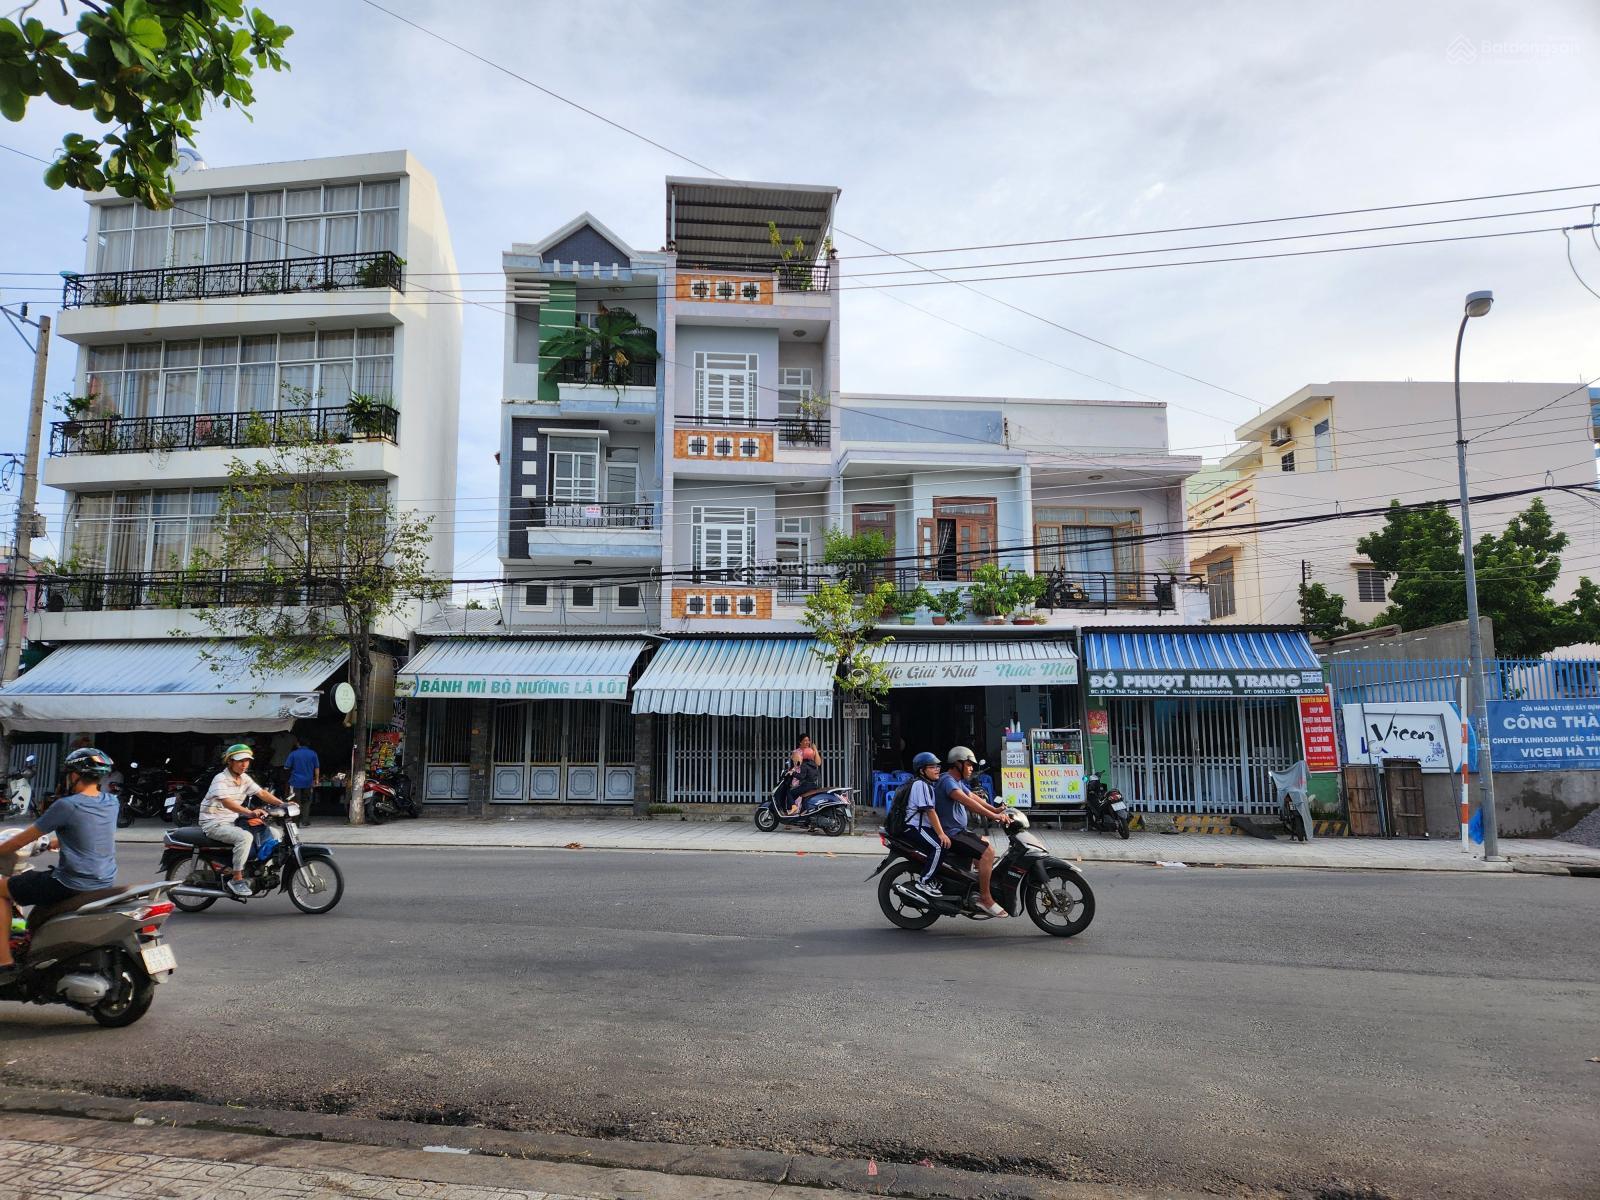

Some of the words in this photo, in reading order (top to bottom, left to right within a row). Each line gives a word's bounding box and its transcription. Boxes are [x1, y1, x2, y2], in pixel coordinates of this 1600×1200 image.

[995, 663, 1036, 678] Nước
[420, 677, 462, 693] BÁNH
[467, 678, 486, 694] MÌ
[491, 678, 511, 694] BÒ
[516, 679, 569, 694] NƯỚNG
[574, 679, 593, 694] LÁ
[598, 678, 626, 694] LỐT
[1089, 671, 1118, 688] ĐỒ
[1122, 674, 1185, 690] PHƯỢT
[1190, 674, 1232, 688] NHA
[1235, 673, 1300, 688] TRANG
[1521, 704, 1533, 712] CỬA
[1503, 713, 1556, 730] CÔNG
[1562, 712, 1600, 728] THÀ
[1492, 735, 1522, 744] CHUYÊN
[1545, 735, 1568, 743] DOANH
[1570, 734, 1584, 742] CÁC
[1521, 747, 1562, 757] VICEM
[1566, 744, 1584, 756] HÀ
[1004, 769, 1028, 779] NƯỚC
[1038, 768, 1060, 777] NƯỚC
